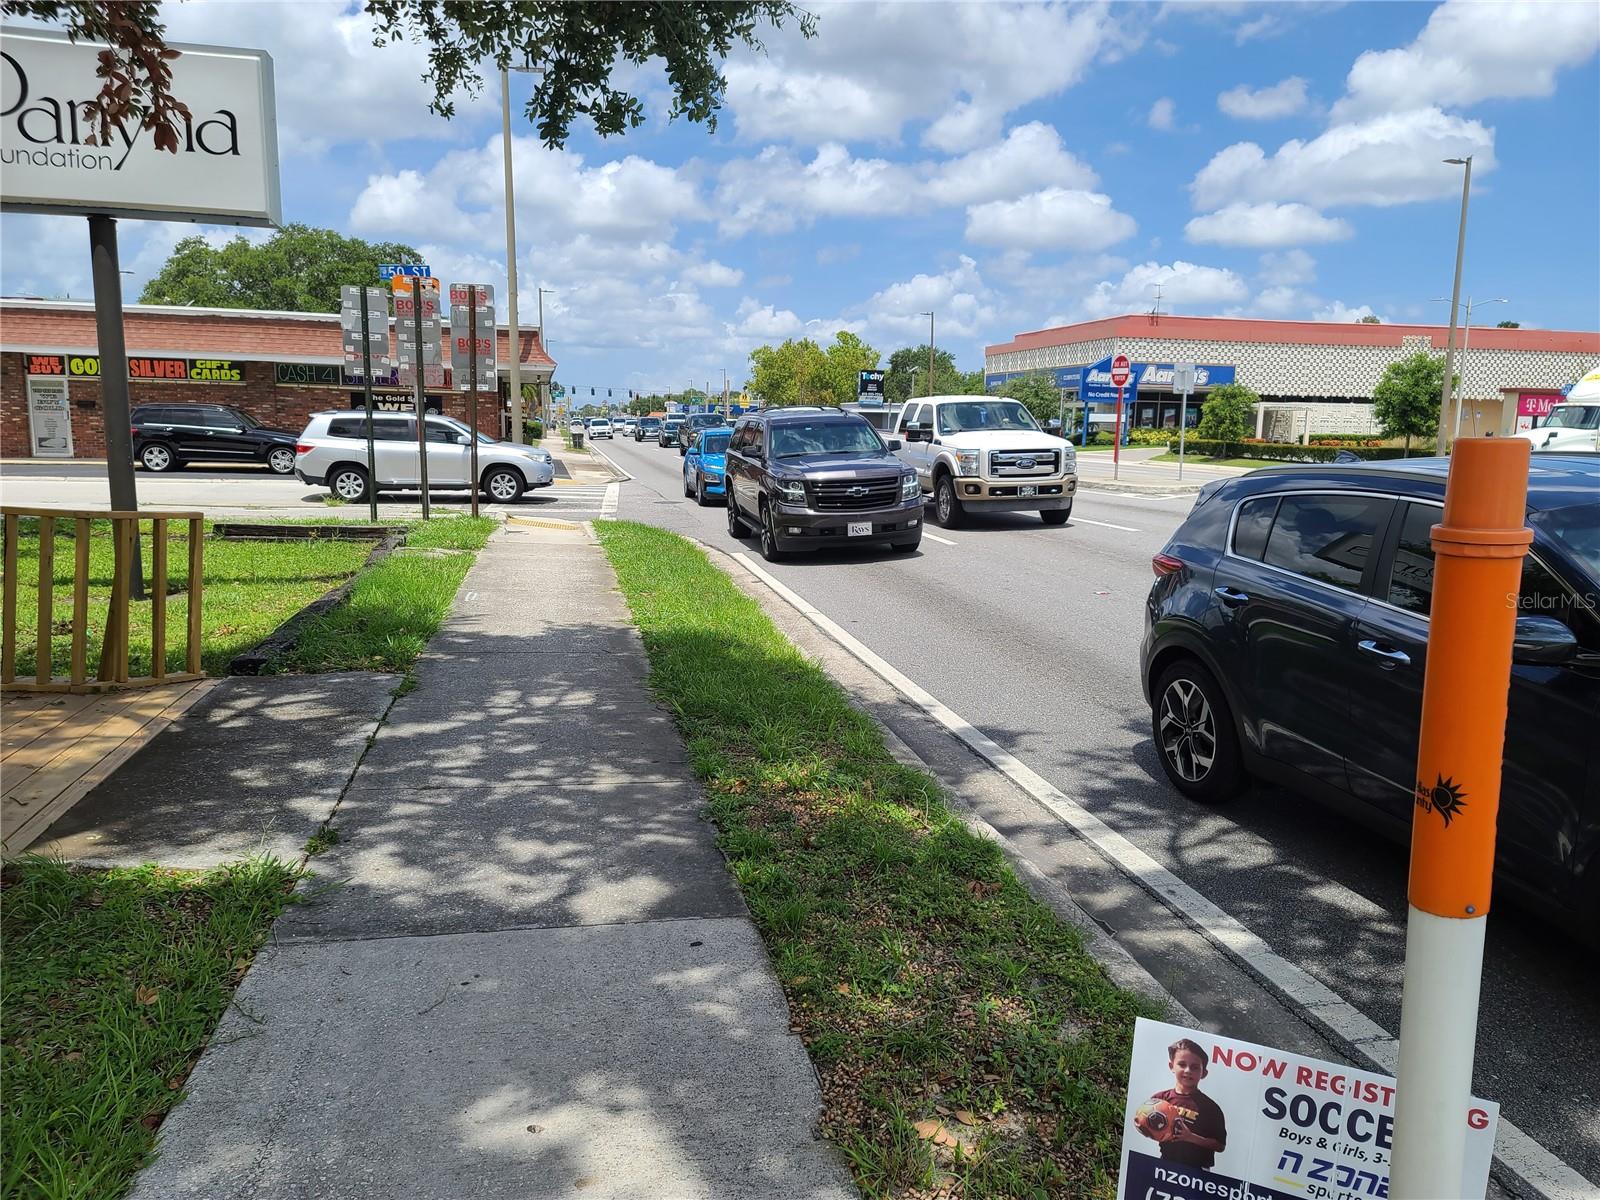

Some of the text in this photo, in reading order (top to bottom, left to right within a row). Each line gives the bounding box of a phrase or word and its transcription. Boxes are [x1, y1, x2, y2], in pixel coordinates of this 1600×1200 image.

[0, 147, 113, 171] undation
[412, 266, 428, 278] ST
[450, 290, 488, 300] BO'S
[396, 300, 434, 310] BO'S
[30, 356, 60, 366] WE
[70, 358, 100, 375] GO
[129, 359, 187, 378] SILVER
[196, 360, 232, 369] GIFT
[30, 365, 63, 374] BUY
[190, 369, 241, 381] CARDS
[278, 363, 317, 383] CASH
[322, 367, 336, 384] 4
[1086, 368, 1136, 384] Aar's
[1139, 364, 1210, 385] Aar's
[1212, 1045, 1288, 1080] NOW
[1262, 1086, 1395, 1150] SOCCE
[1278, 1127, 1313, 1145] Boys
[1315, 1136, 1328, 1150] &
